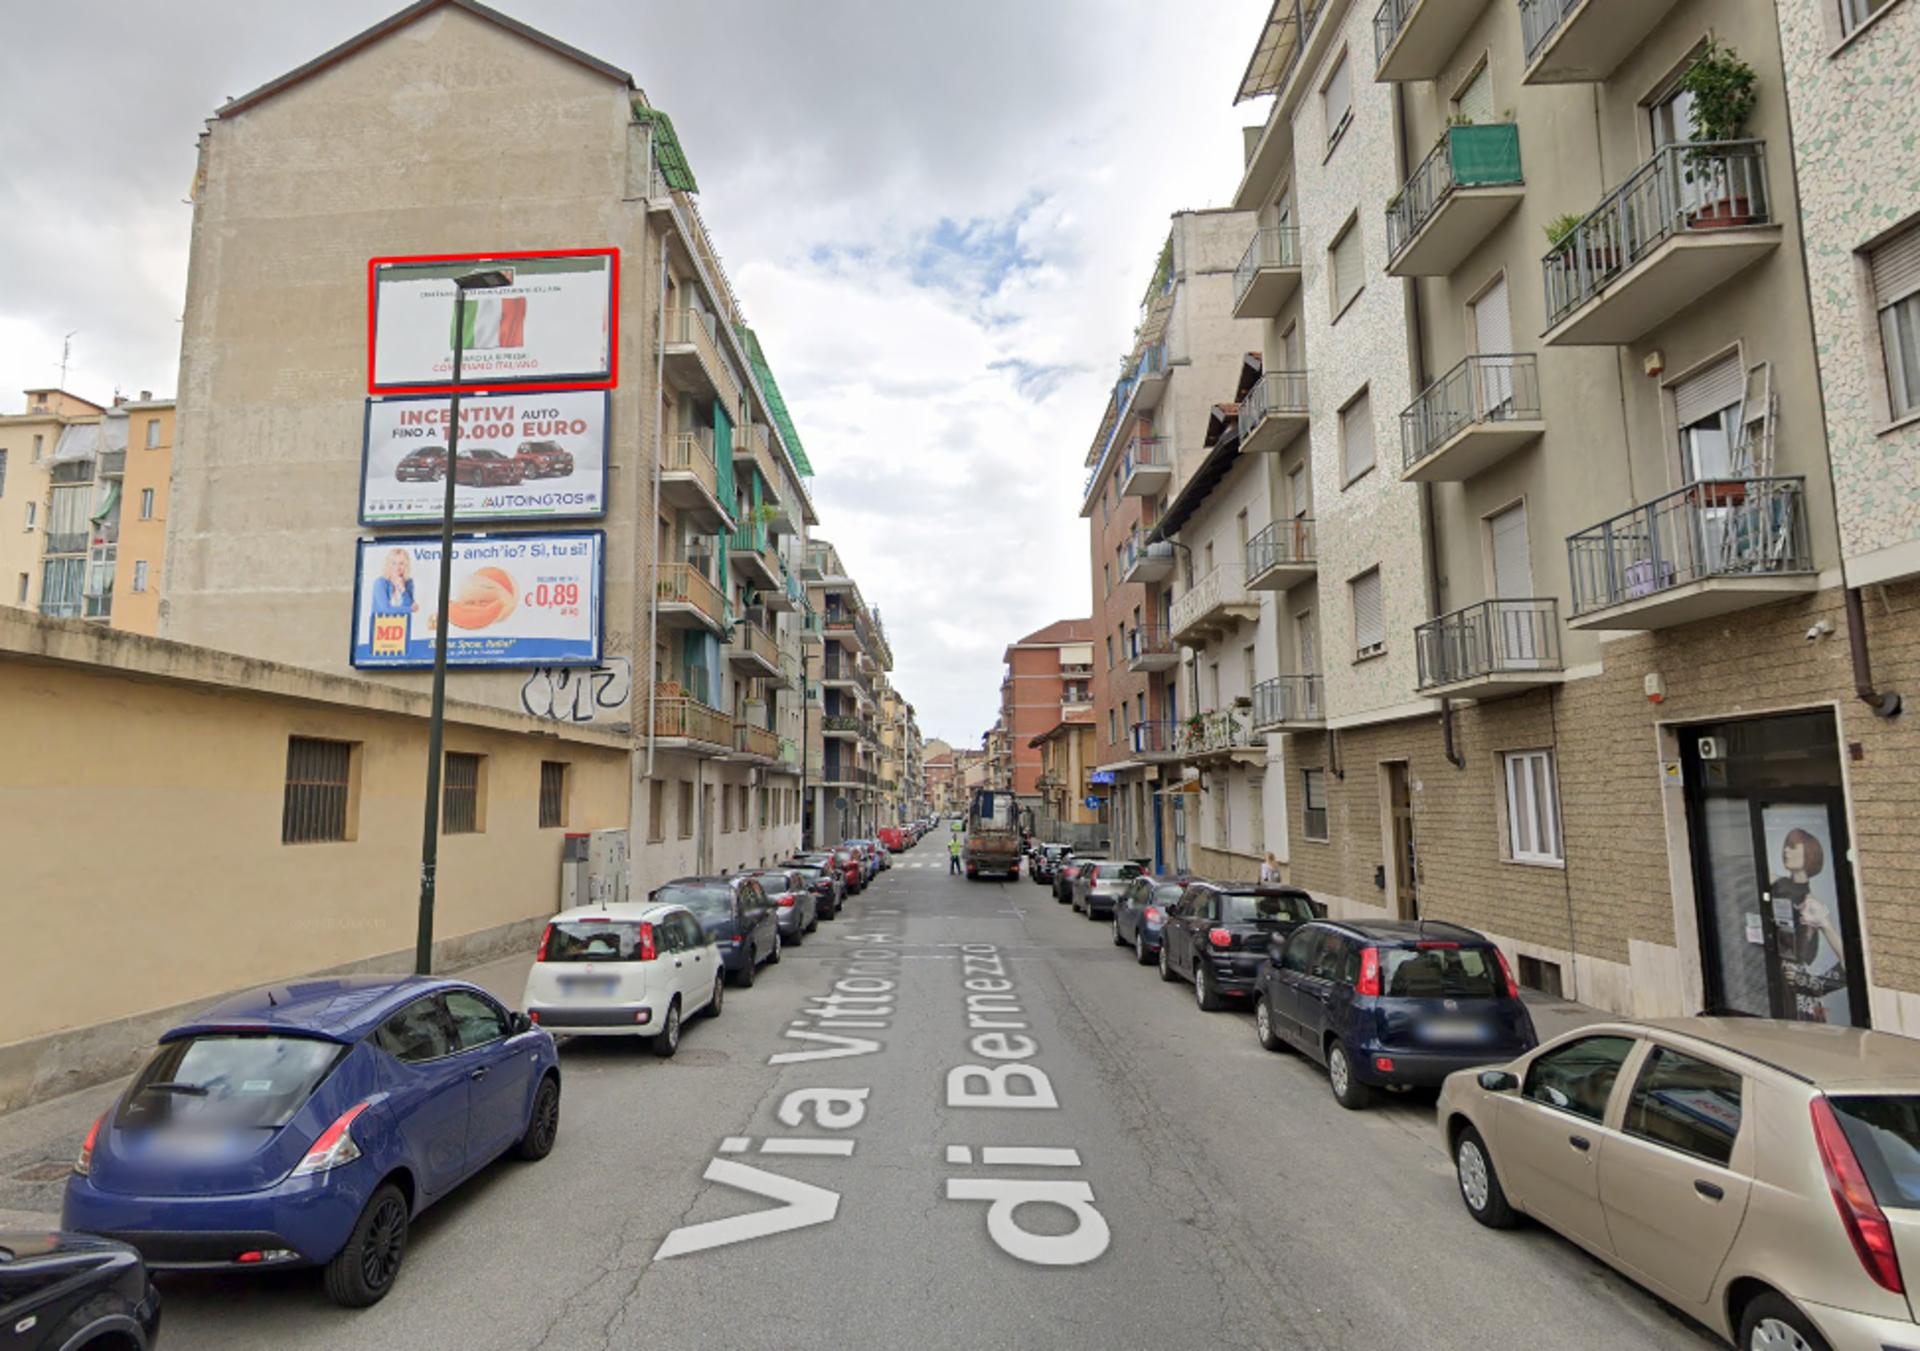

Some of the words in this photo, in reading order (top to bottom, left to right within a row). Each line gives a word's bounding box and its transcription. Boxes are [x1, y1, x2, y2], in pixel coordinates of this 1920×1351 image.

[400, 406, 515, 425] INCENTIVI
[521, 408, 560, 420] AUTO
[392, 428, 423, 438] FINO
[426, 427, 436, 437] A
[522, 418, 588, 437] EURO
[414, 547, 459, 560] Veno
[552, 543, 569, 556] tu
[376, 625, 404, 641] MD
